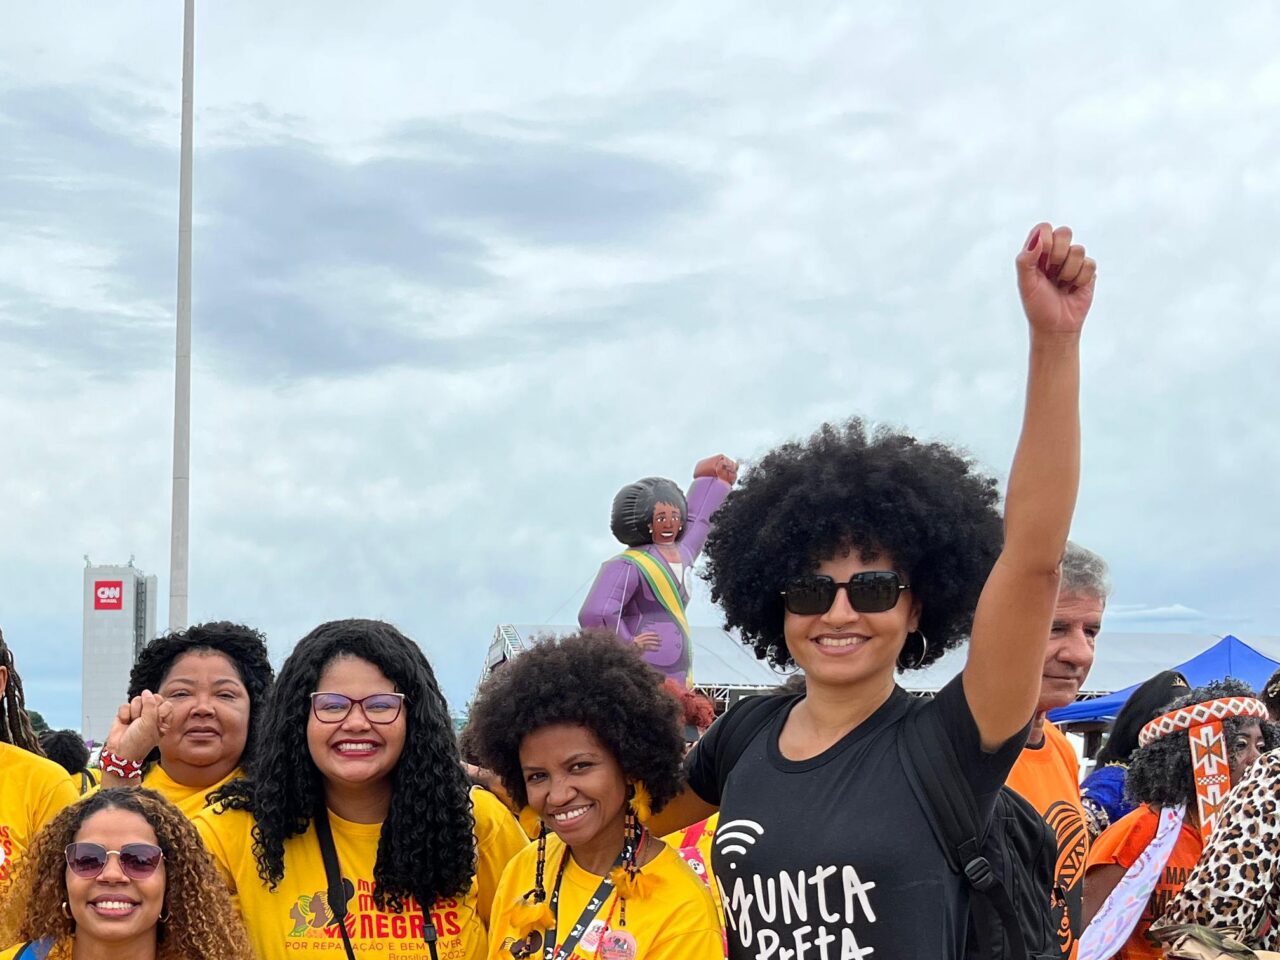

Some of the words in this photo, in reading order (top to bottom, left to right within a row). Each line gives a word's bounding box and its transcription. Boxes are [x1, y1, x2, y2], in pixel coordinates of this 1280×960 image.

[97, 587, 120, 599] CNN
[285, 941, 308, 950] POR
[313, 940, 384, 953] REPAAÇÃO
[389, 942, 396, 951] E
[401, 942, 426, 951] BEM
[441, 949, 466, 960] 2025
